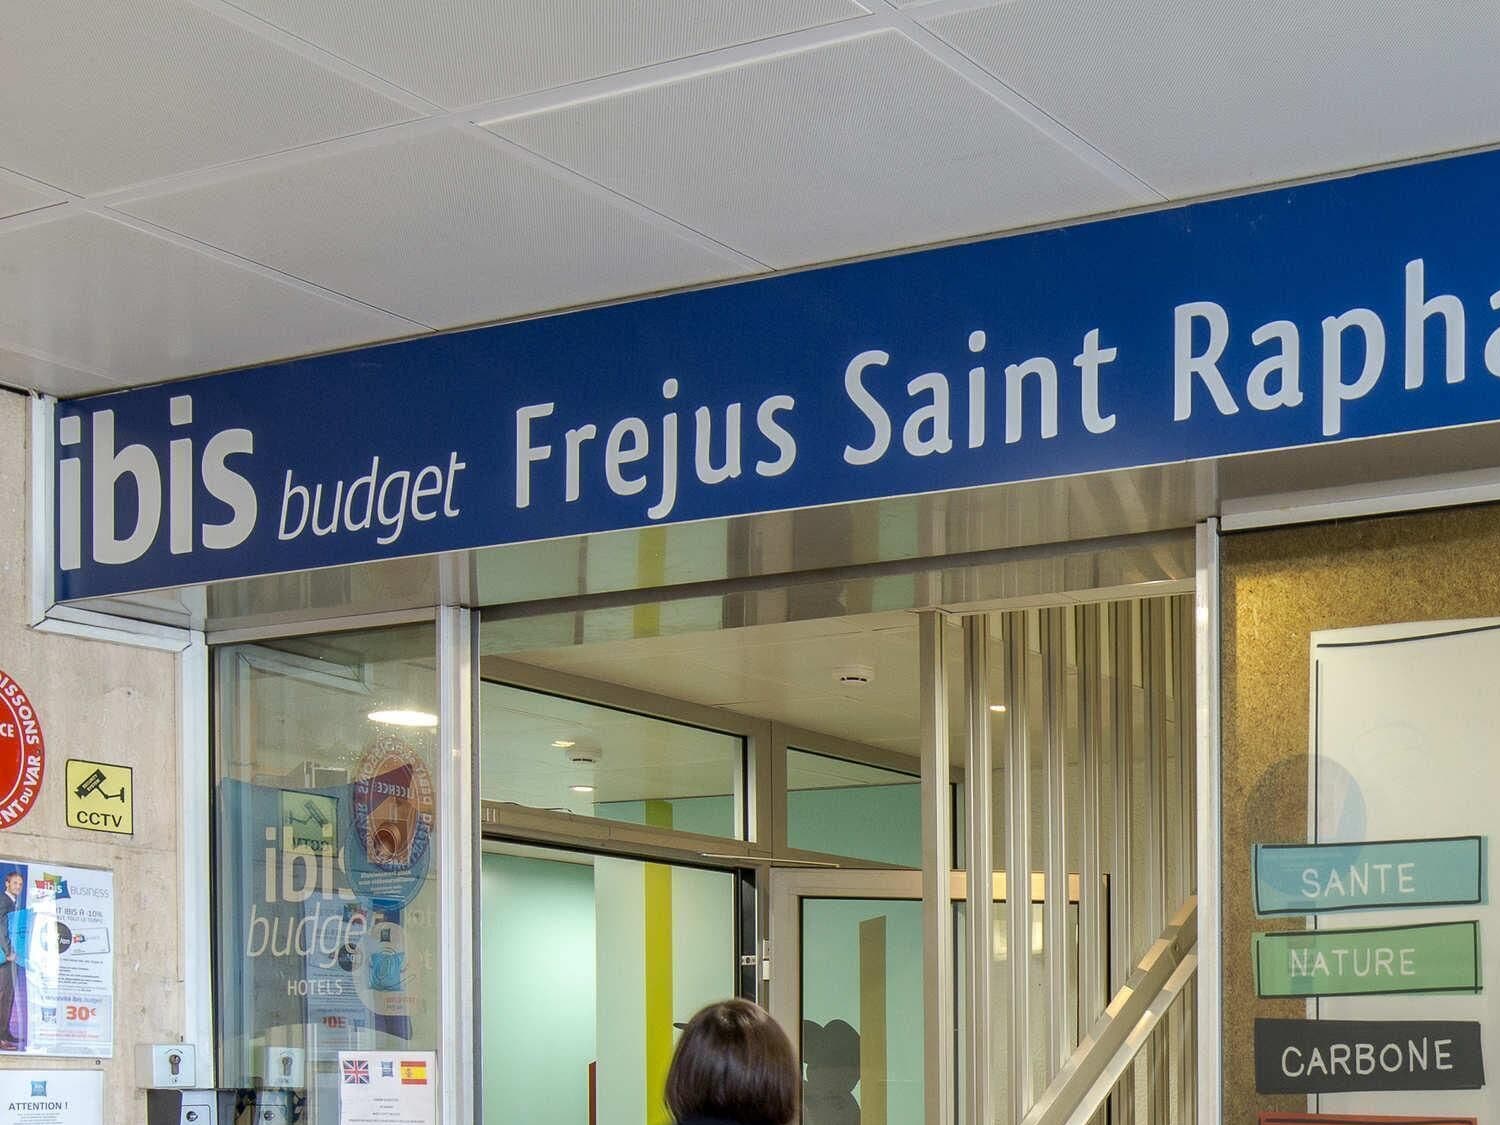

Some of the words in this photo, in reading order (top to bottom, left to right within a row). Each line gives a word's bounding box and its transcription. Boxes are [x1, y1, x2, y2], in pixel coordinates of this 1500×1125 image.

[59, 395, 258, 571] ibis
[278, 452, 466, 545] budget
[516, 378, 797, 519] Frejus
[844, 328, 1117, 466] Saint
[0, 676, 39, 744] ISSONS
[76, 810, 123, 828] CCTV
[1301, 863, 1416, 898] SANTE
[1290, 948, 1416, 978] NATURE
[287, 979, 344, 996] HOTELS
[1281, 1039, 1453, 1078] CARBONE
[8, 1102, 62, 1111] ATTENTION
